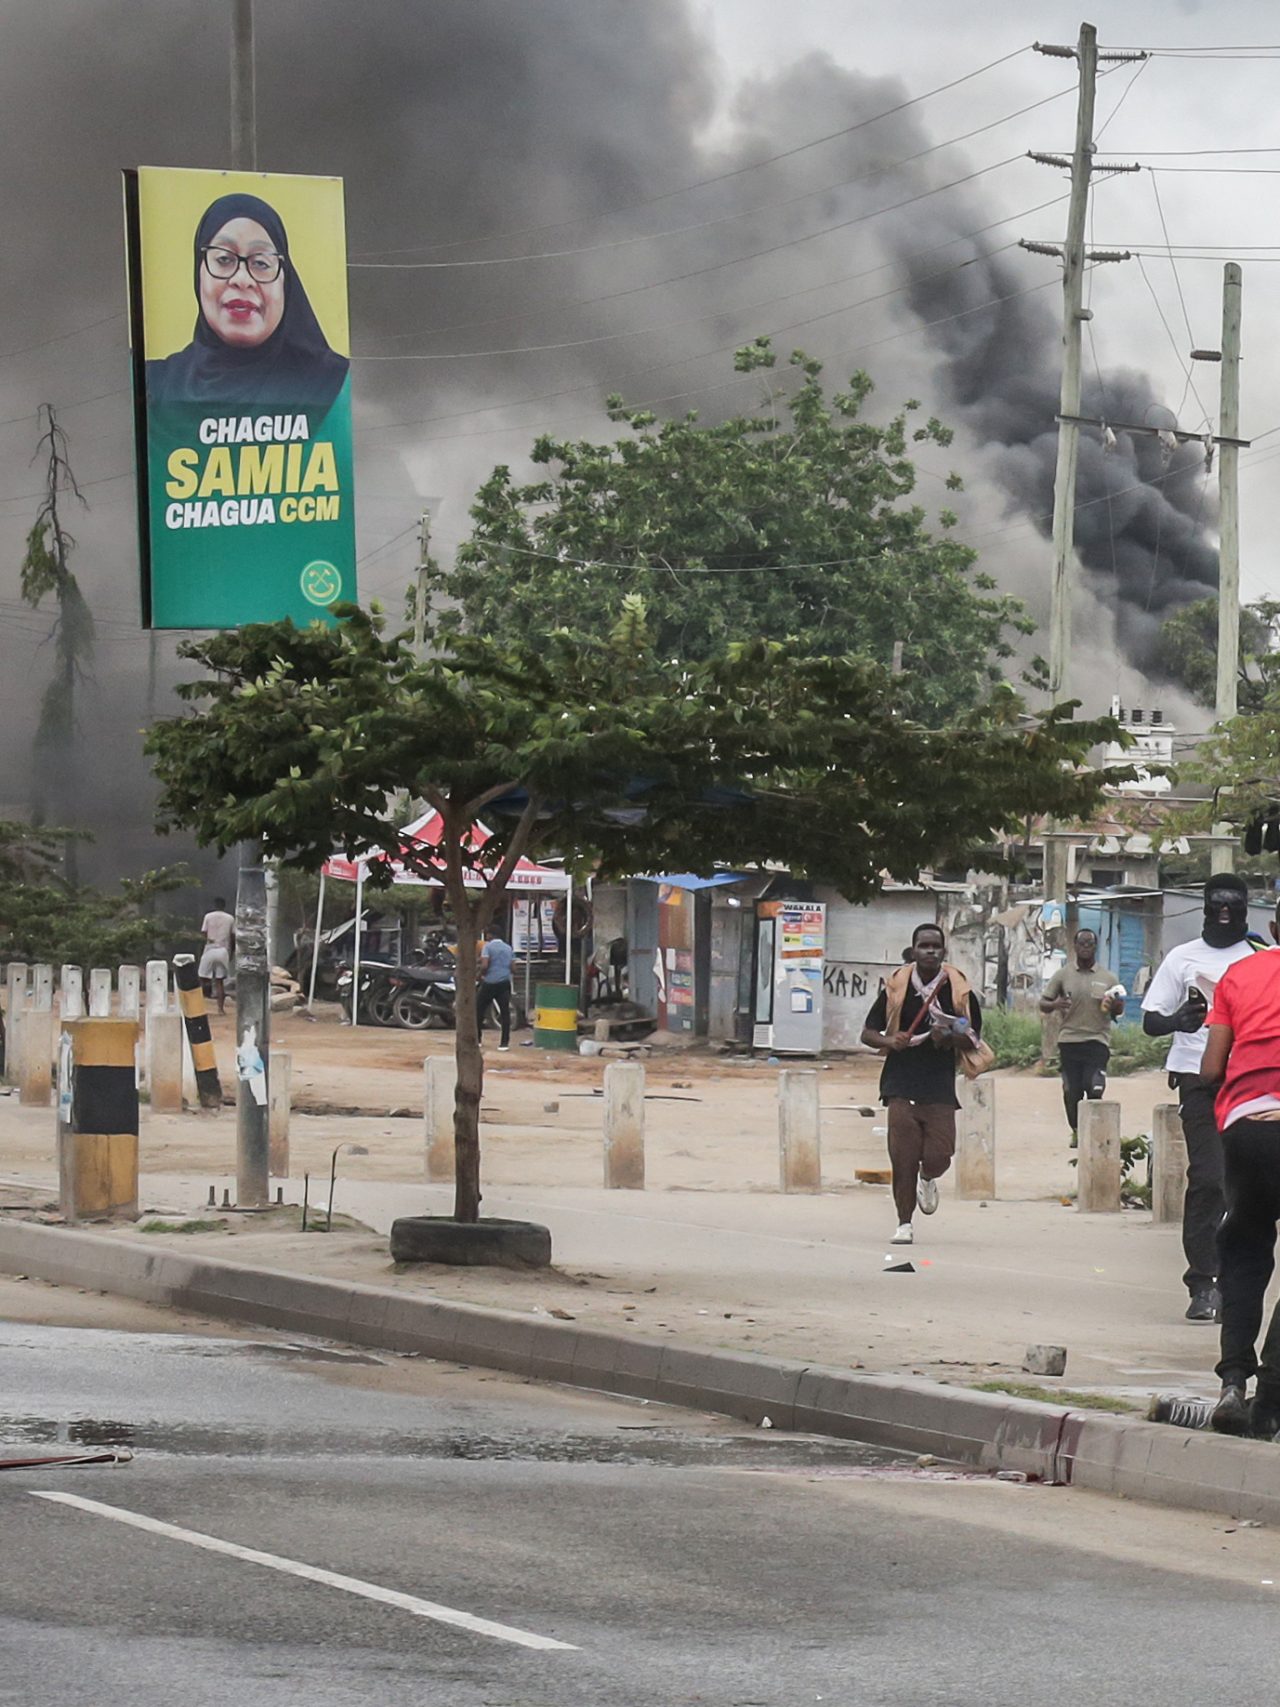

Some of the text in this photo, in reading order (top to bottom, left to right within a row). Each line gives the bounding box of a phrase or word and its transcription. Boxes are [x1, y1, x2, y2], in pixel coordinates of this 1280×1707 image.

[199, 414, 309, 444] CHAGUA
[165, 442, 340, 499] SAMIA
[165, 495, 341, 529] CHAGUA CCM
